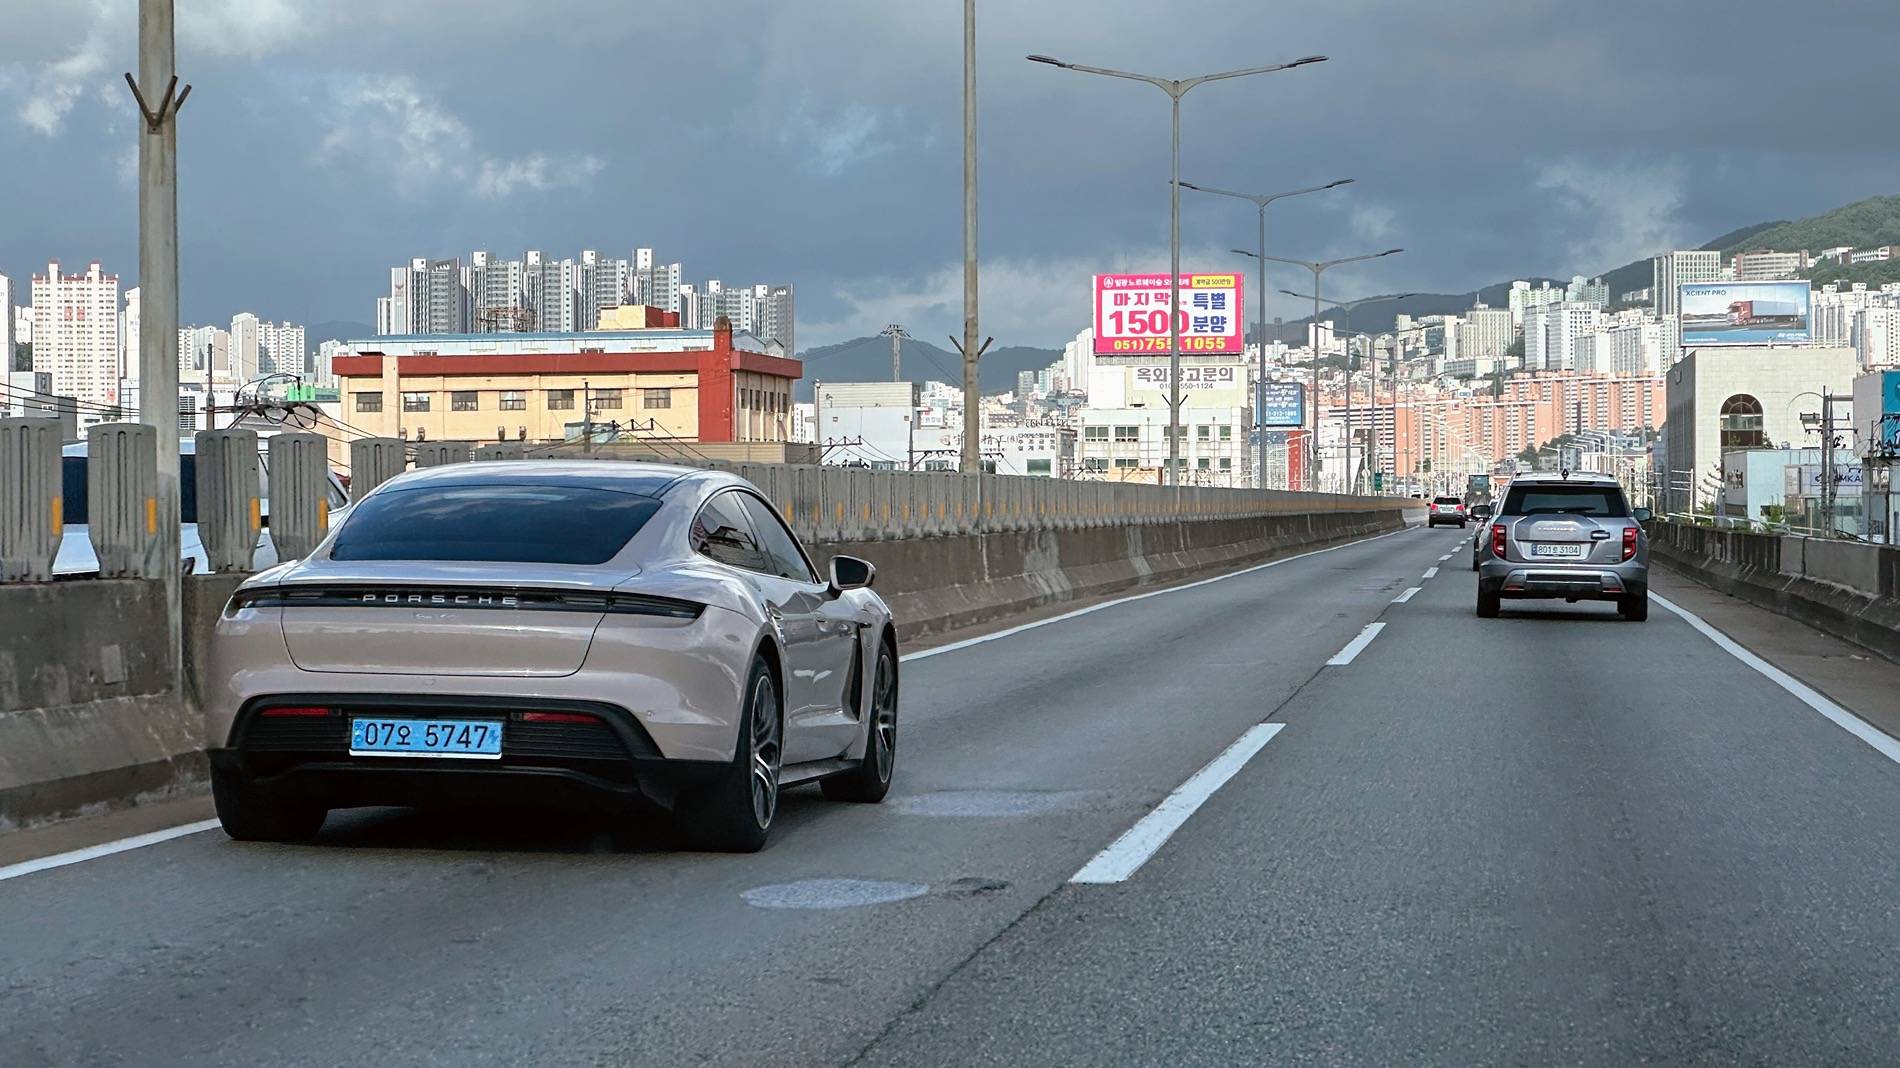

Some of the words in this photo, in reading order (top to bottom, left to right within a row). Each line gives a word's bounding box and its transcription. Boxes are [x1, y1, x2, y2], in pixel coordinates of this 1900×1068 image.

[1113, 292, 1171, 306] 마지막
[1193, 292, 1226, 310] 특별
[1109, 310, 1190, 335] 1500
[1193, 315, 1227, 333] 분양
[1559, 545, 1578, 554] 3104
[362, 594, 518, 605] PORSCHE
[365, 722, 411, 746] 07오
[425, 724, 489, 748] 5747
